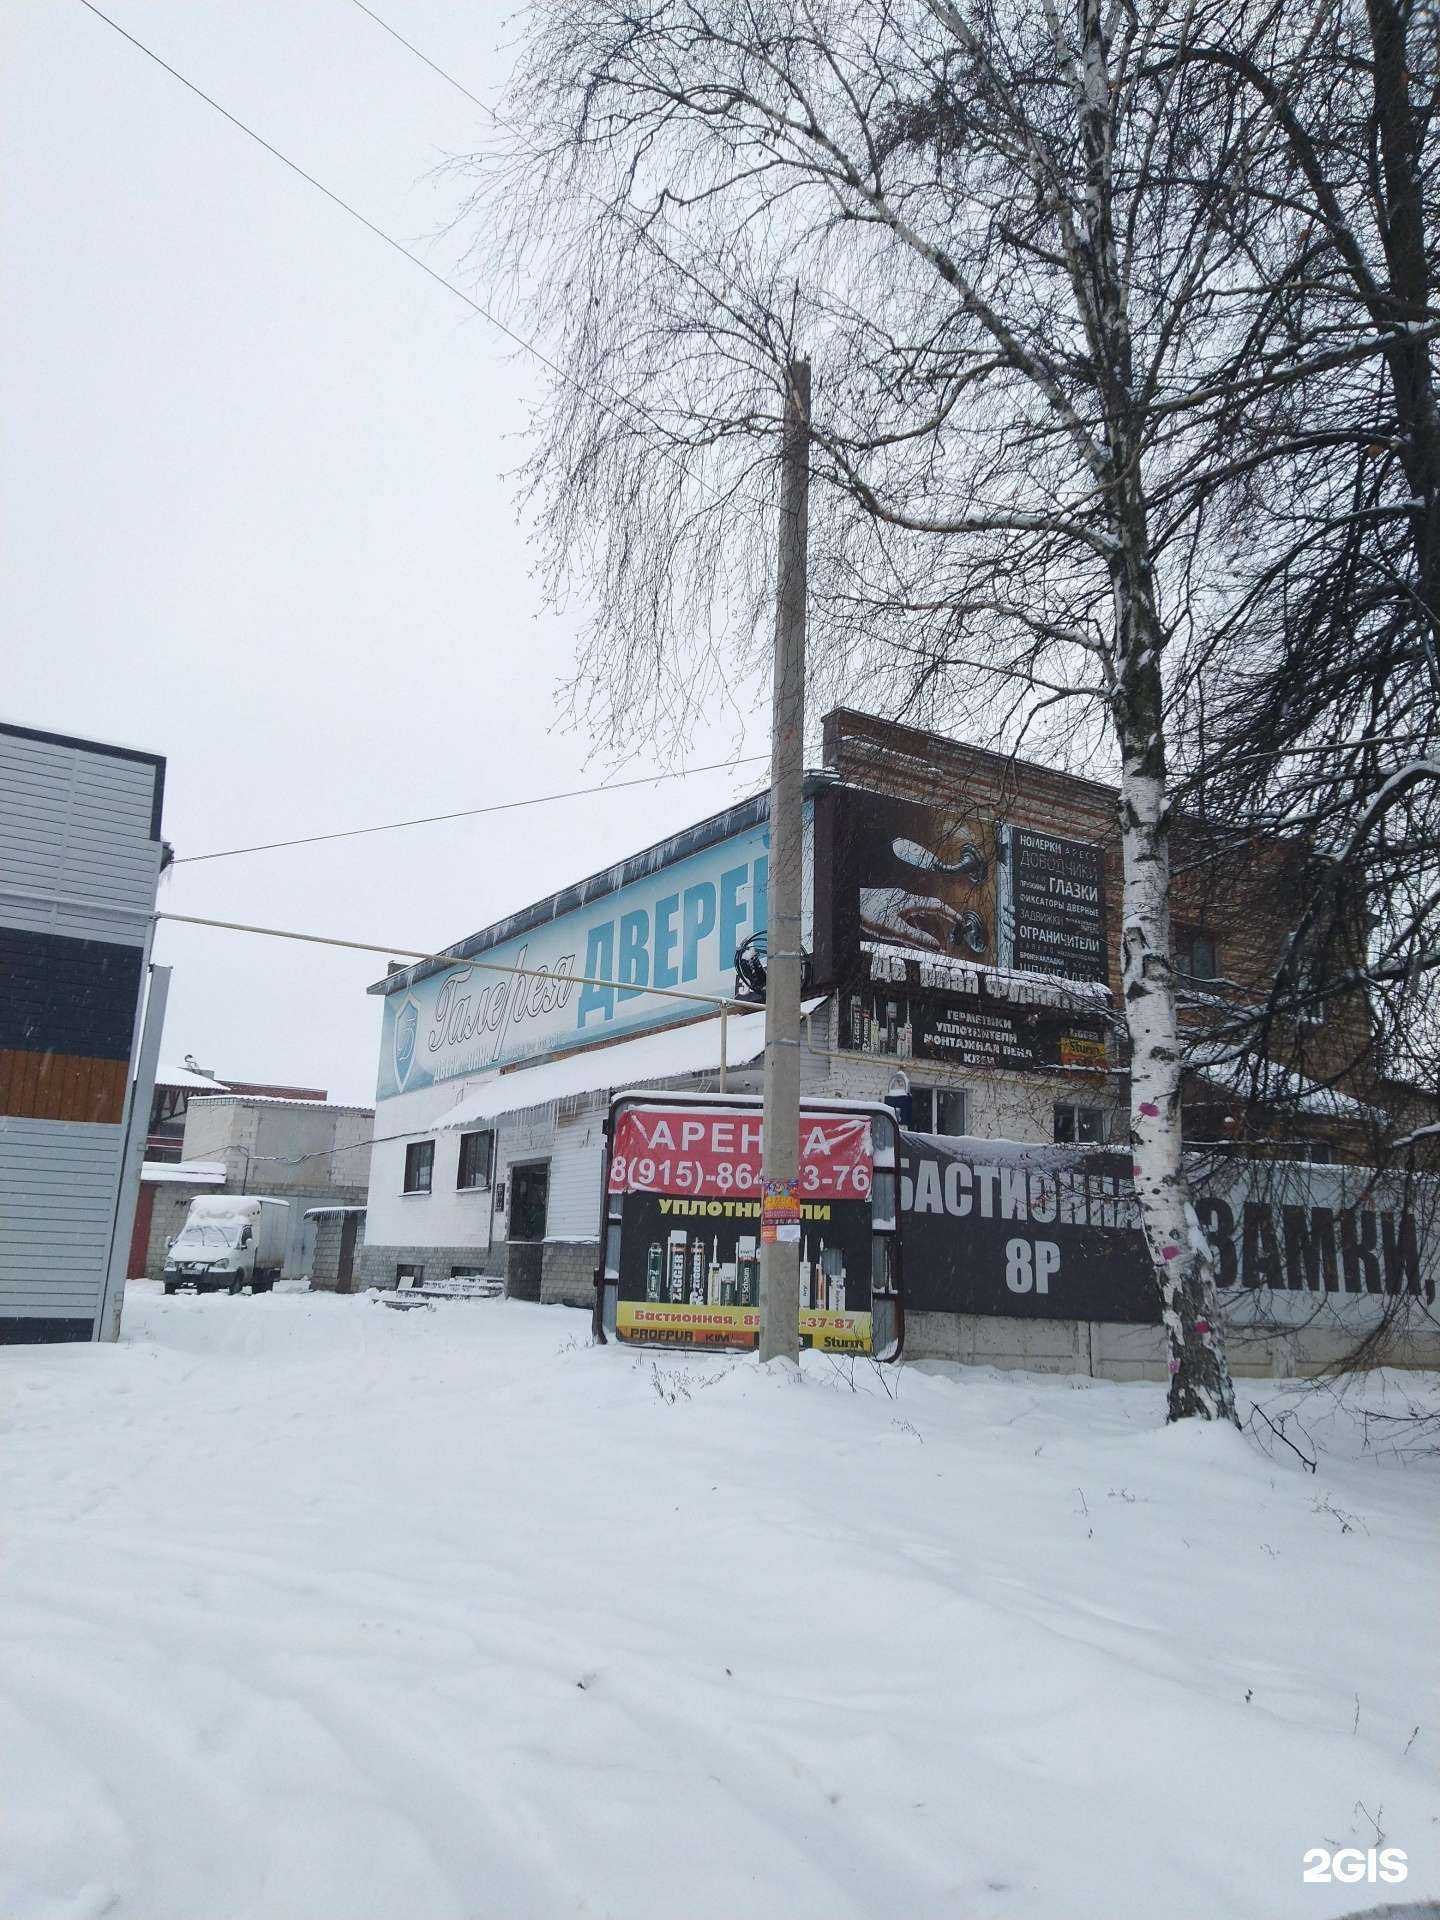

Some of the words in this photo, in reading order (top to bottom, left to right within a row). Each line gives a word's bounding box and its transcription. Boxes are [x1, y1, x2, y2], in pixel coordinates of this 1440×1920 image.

[1020, 834, 1062, 854] НОМЕРКИ
[1049, 877, 1098, 902] ГЛАЗКИ
[1020, 893, 1065, 910] ФИКСАТОРЫ
[1066, 903, 1099, 918] ДВЕРНЫЕ
[1019, 925, 1100, 952] ОГРАНИЧИТЕЛИ
[428, 943, 576, 1063] Галерея
[946, 1009, 1012, 1029] ГЕРМЕТИКИ
[923, 1033, 1000, 1054] МОНТАЖНАЯ
[648, 1120, 831, 1156] АРЕНА
[658, 1199, 832, 1220] УПЛОТНИЛИ
[1005, 1238, 1061, 1294] 8Р
[633, 1310, 737, 1327] Бастионная,
